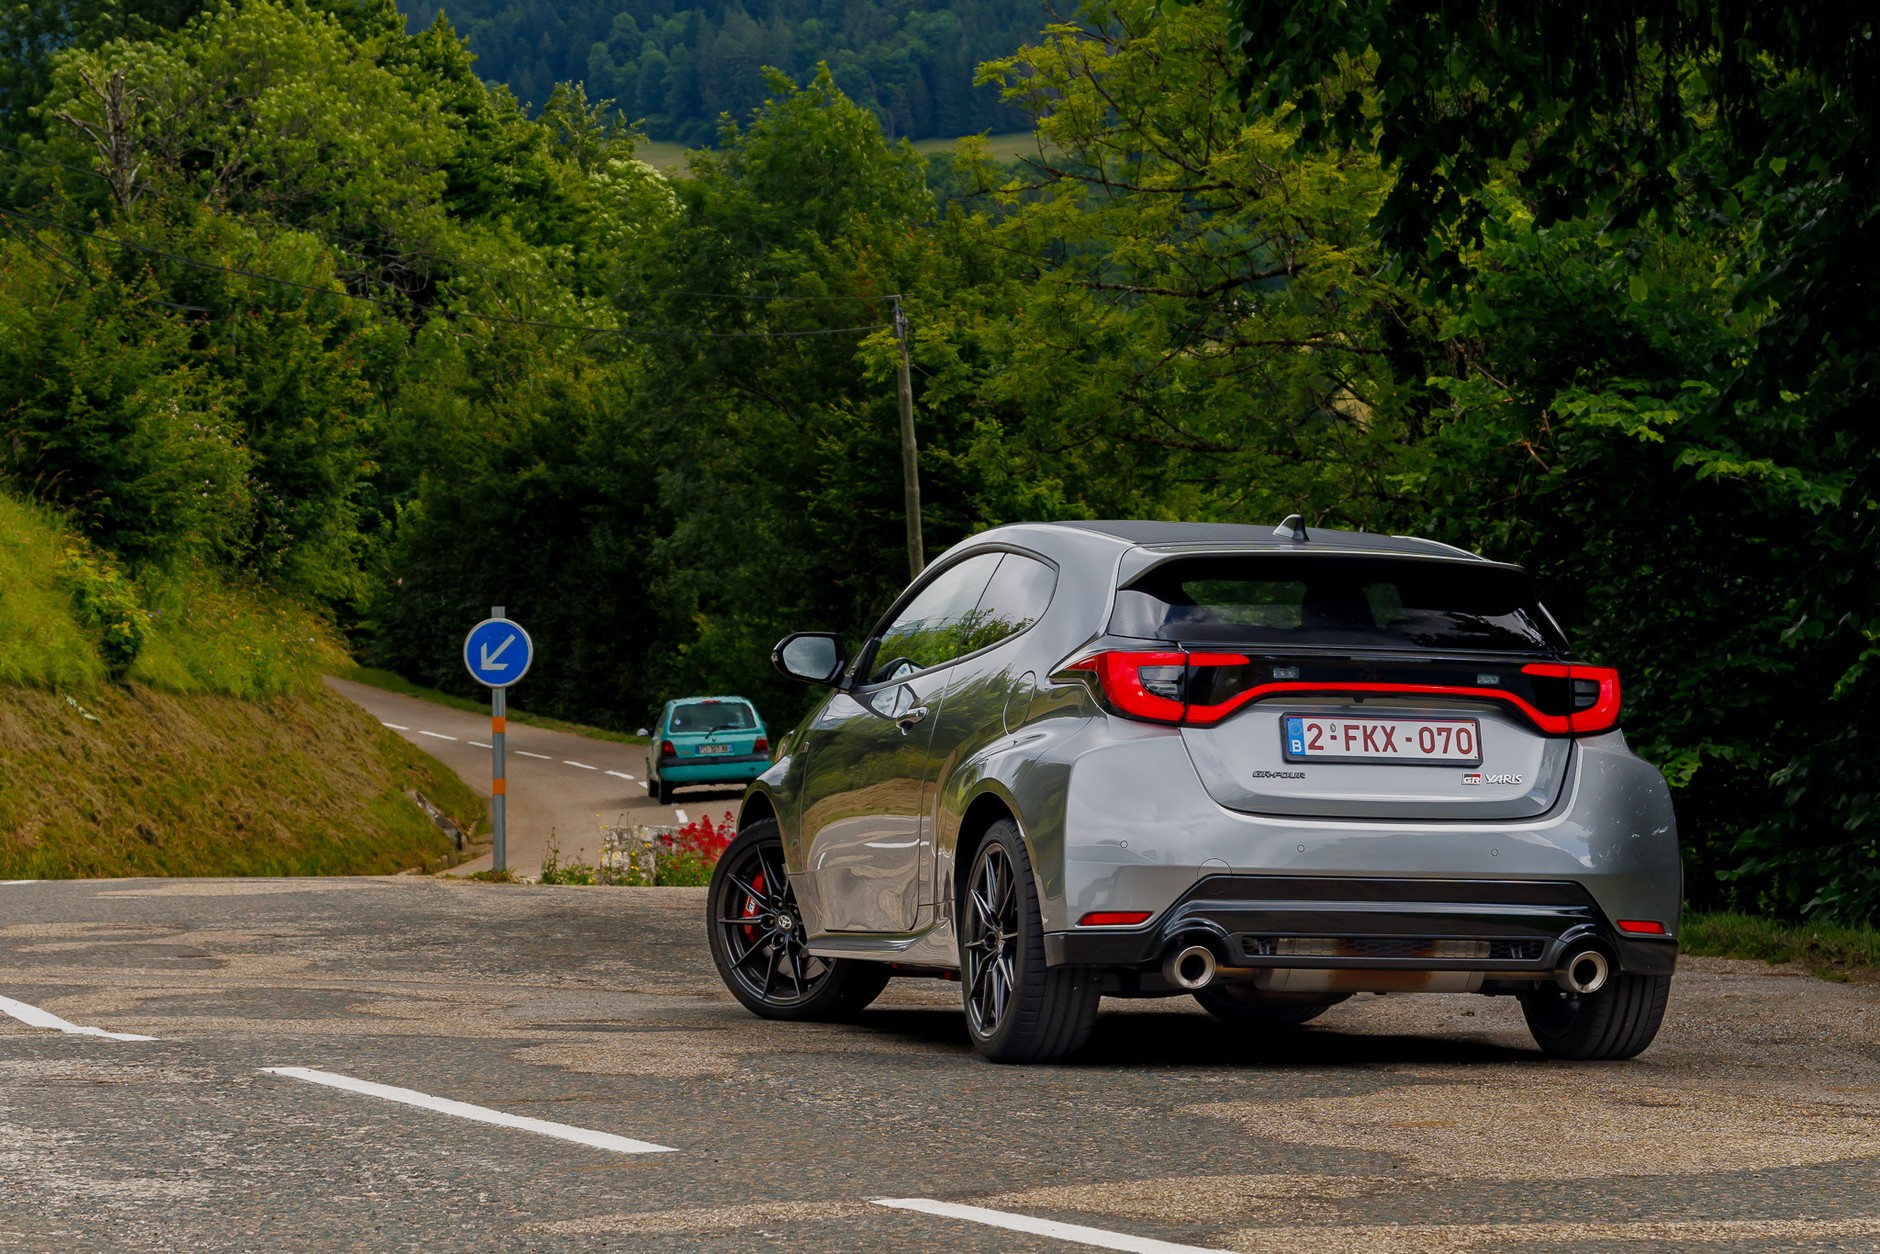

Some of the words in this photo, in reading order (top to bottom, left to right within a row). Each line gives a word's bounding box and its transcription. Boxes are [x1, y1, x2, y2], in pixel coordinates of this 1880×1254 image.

[1291, 740, 1302, 753] B
[1252, 770, 1306, 780] GR-FOUR
[1462, 776, 1480, 785] GR
[1485, 773, 1523, 785] YARIS
